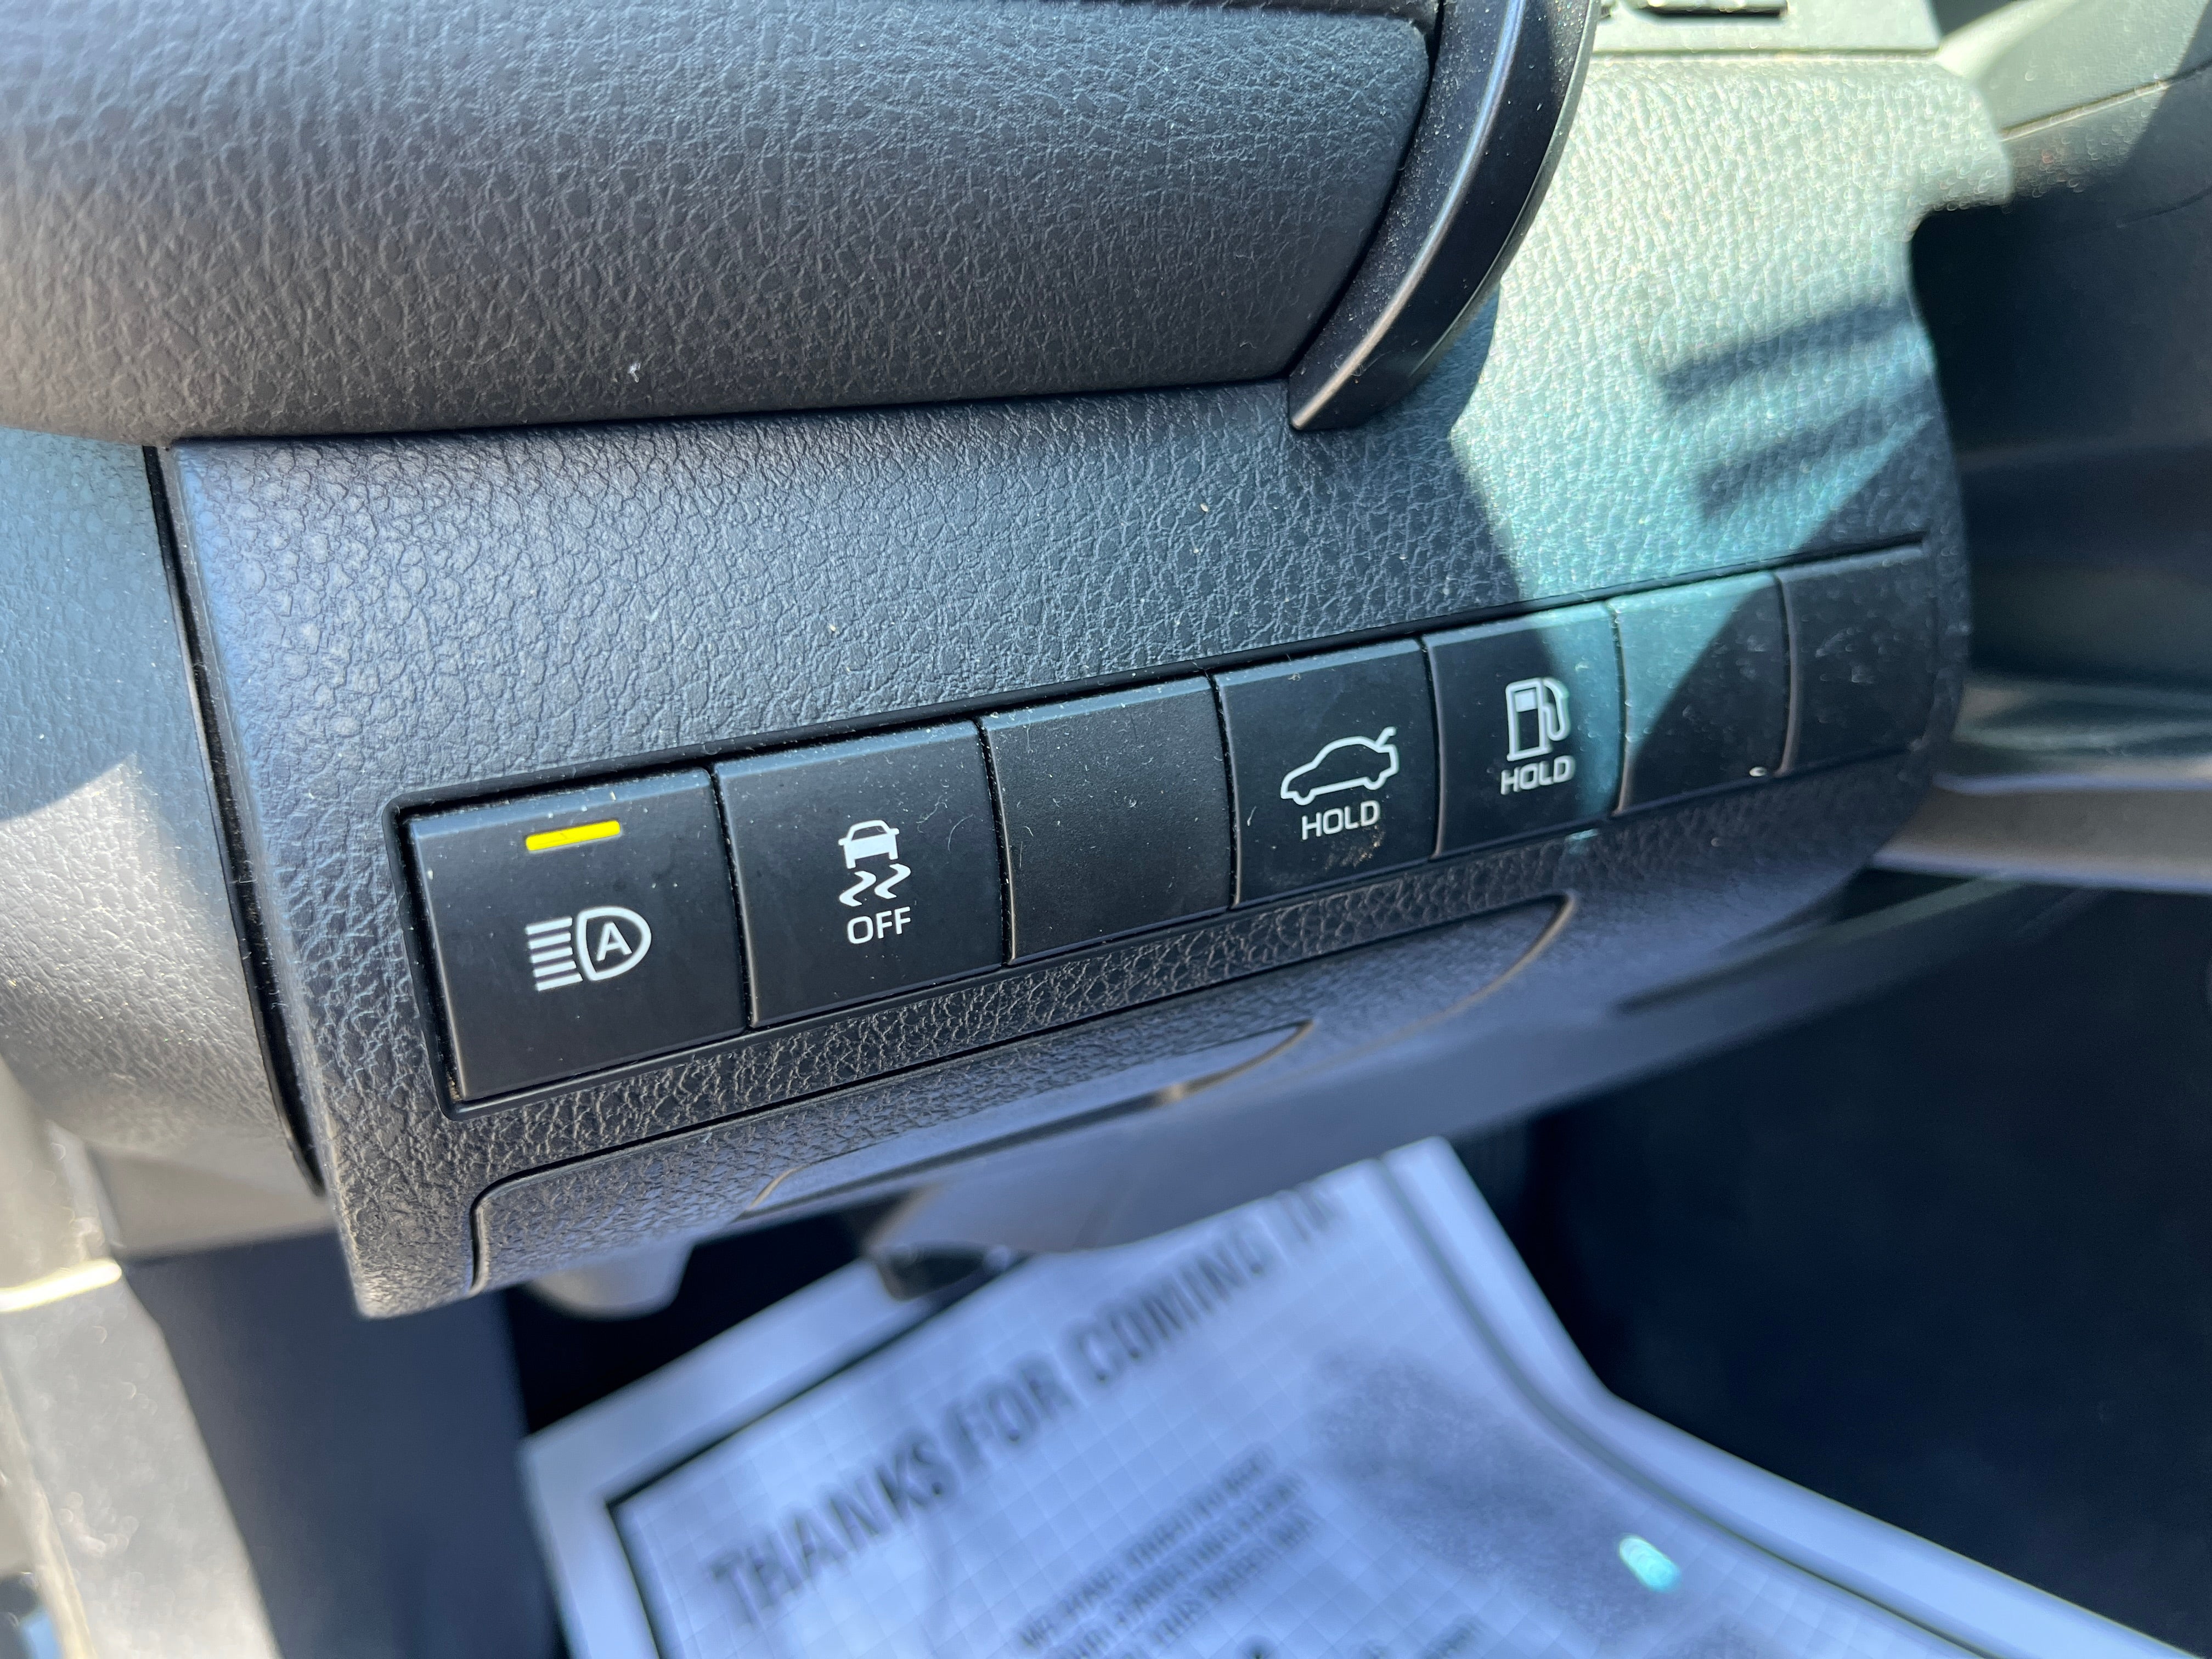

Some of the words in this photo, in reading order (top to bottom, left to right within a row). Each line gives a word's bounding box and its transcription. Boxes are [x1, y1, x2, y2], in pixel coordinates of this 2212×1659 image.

[1501, 757, 1575, 794] HOLD
[1301, 800, 1380, 840] HOLD
[597, 922, 632, 962] A
[847, 907, 911, 944] OFF
[703, 1429, 950, 1625] THANKS
[946, 1355, 1071, 1476] FOR
[1071, 1226, 1272, 1384] COMING
